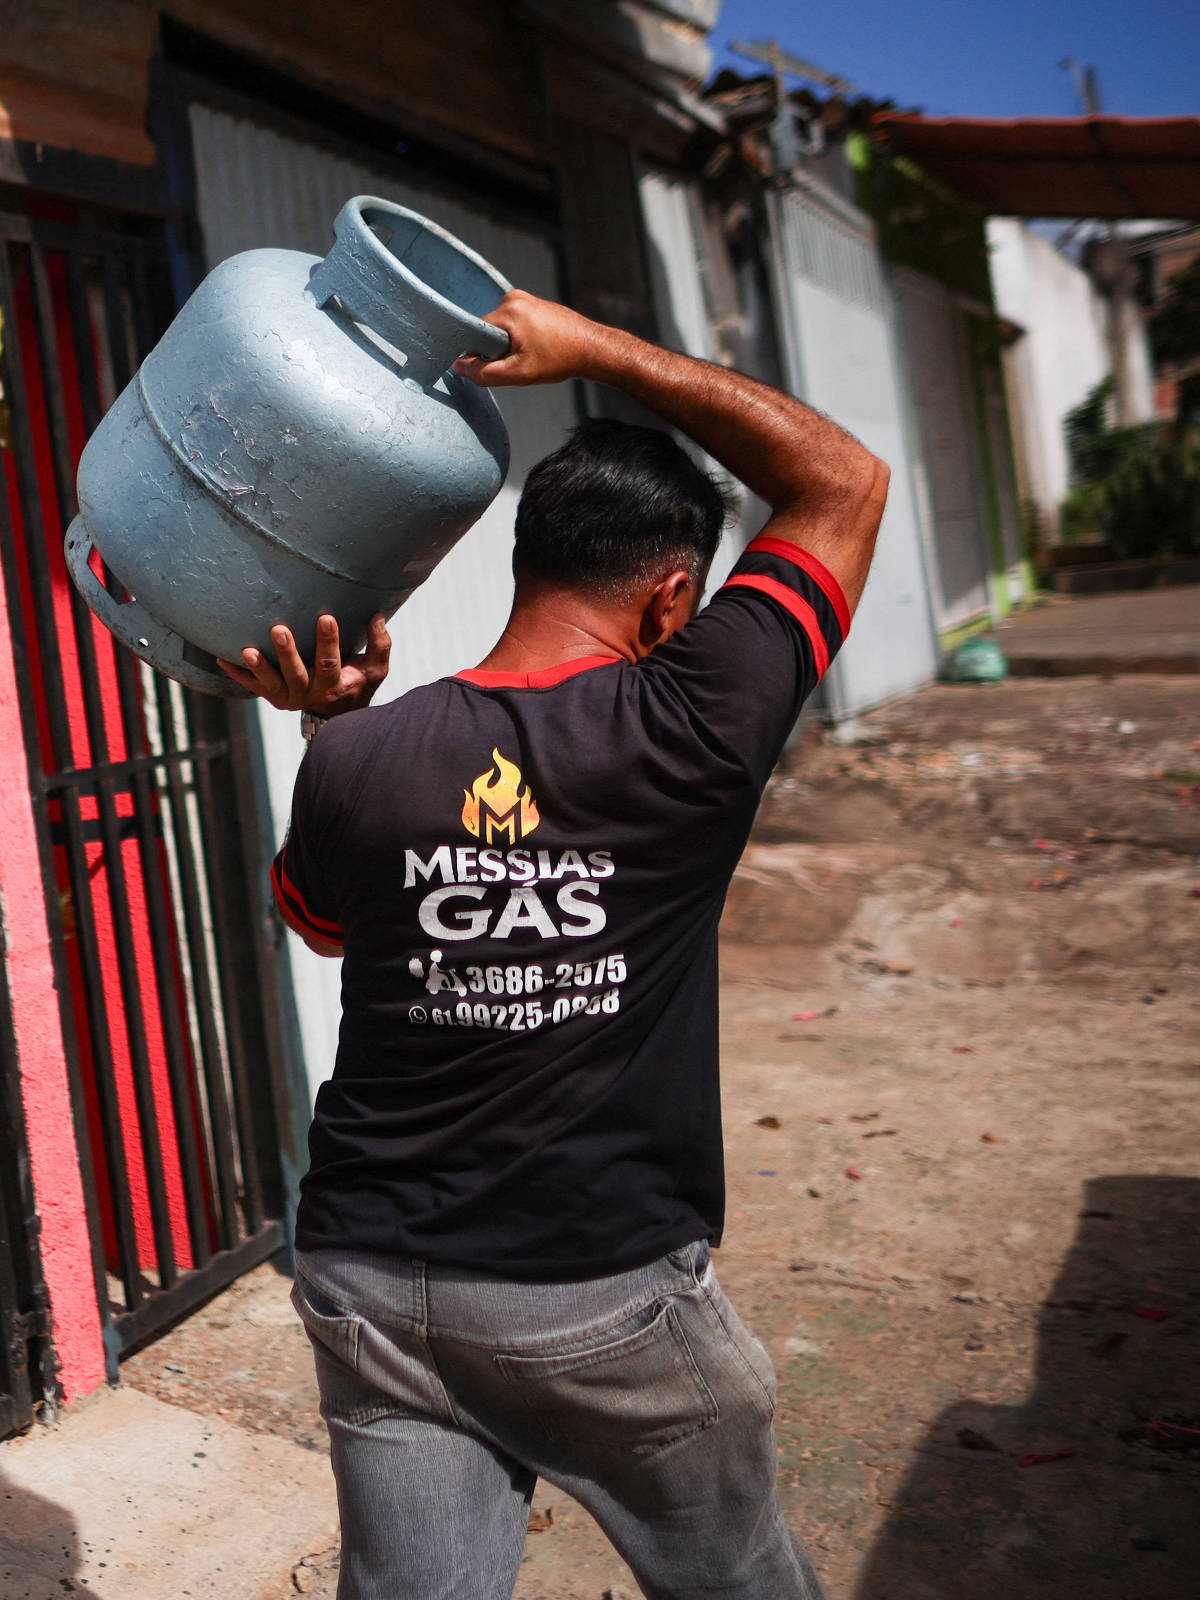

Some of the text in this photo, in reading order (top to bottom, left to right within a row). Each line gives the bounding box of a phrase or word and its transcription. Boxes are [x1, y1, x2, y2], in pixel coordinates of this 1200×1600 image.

[403, 846, 616, 889] MESSIAS
[418, 879, 607, 941] GÁS
[465, 954, 628, 995] 3686-2575
